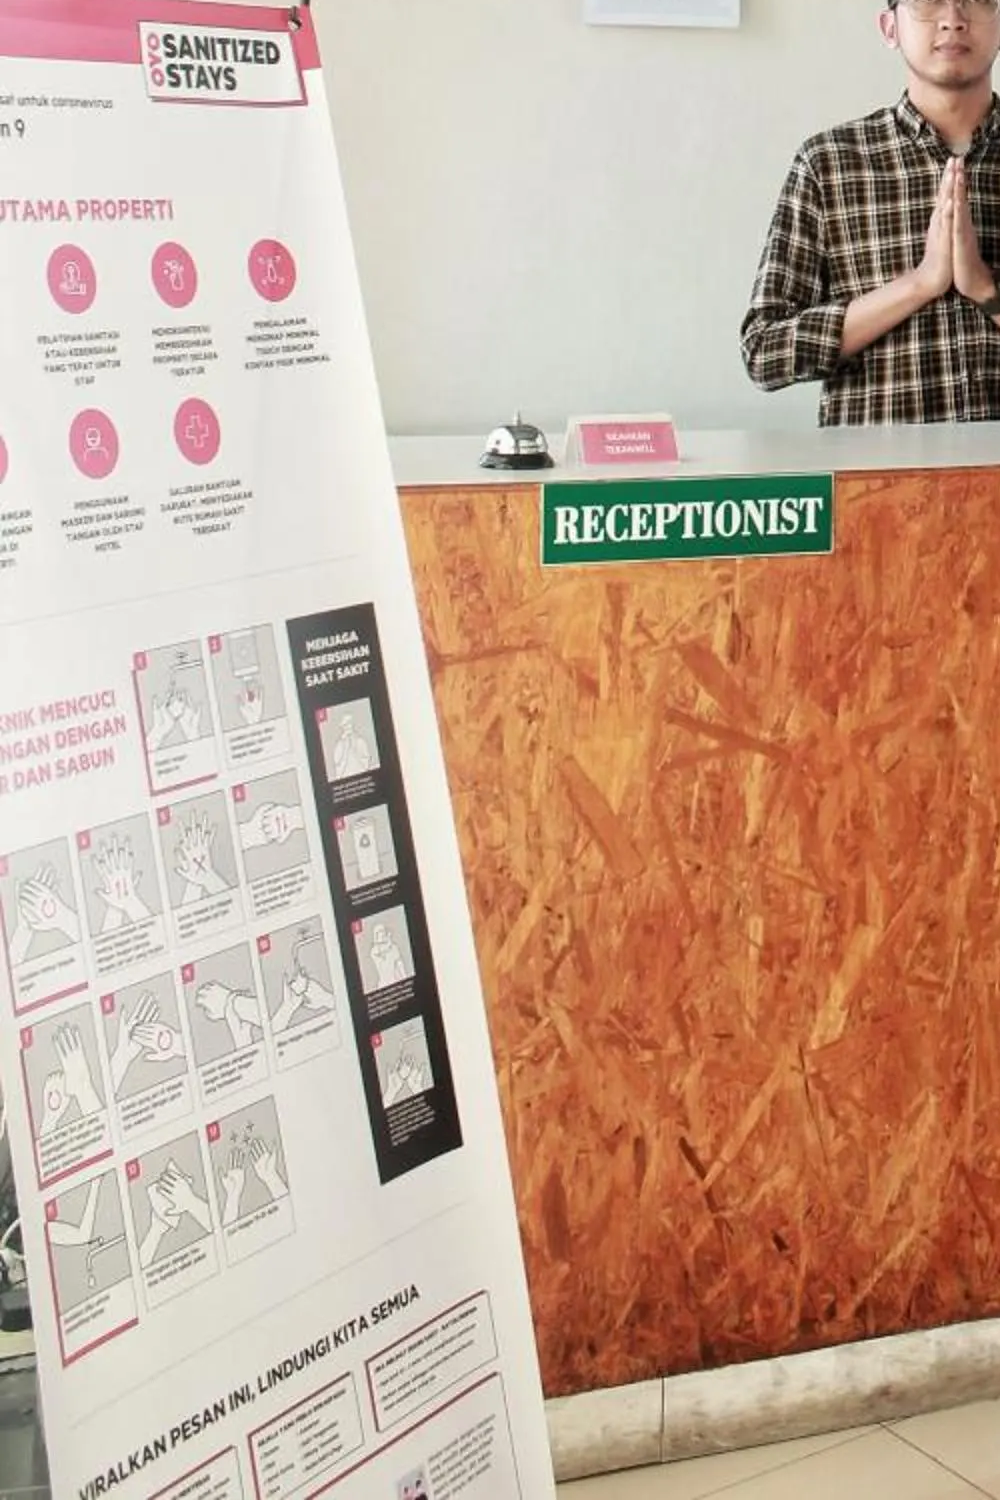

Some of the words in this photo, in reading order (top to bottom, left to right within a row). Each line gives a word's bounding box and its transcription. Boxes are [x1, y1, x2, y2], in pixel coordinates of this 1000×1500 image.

[147, 32, 165, 87] OYO
[163, 33, 281, 65] SANITIZED
[166, 63, 237, 91] STAYS
[14, 118, 25, 138] 9
[75, 199, 175, 222] PROPERTI
[552, 496, 825, 546] RECEPTIONIST
[305, 631, 359, 653] MENJAGA
[305, 669, 335, 688] SAAT
[336, 660, 372, 681] SAKIT
[39, 688, 118, 725] MENCUCI
[54, 713, 128, 750] DENGAN
[13, 761, 52, 792] DAN
[55, 745, 117, 780] SABUN
[78, 1435, 168, 1500] VIRALKAN
[168, 1401, 228, 1451] PESAN
[256, 1335, 332, 1395] LINDUNGI
[332, 1314, 371, 1348] KITA
[370, 1283, 421, 1326] SEMUA
